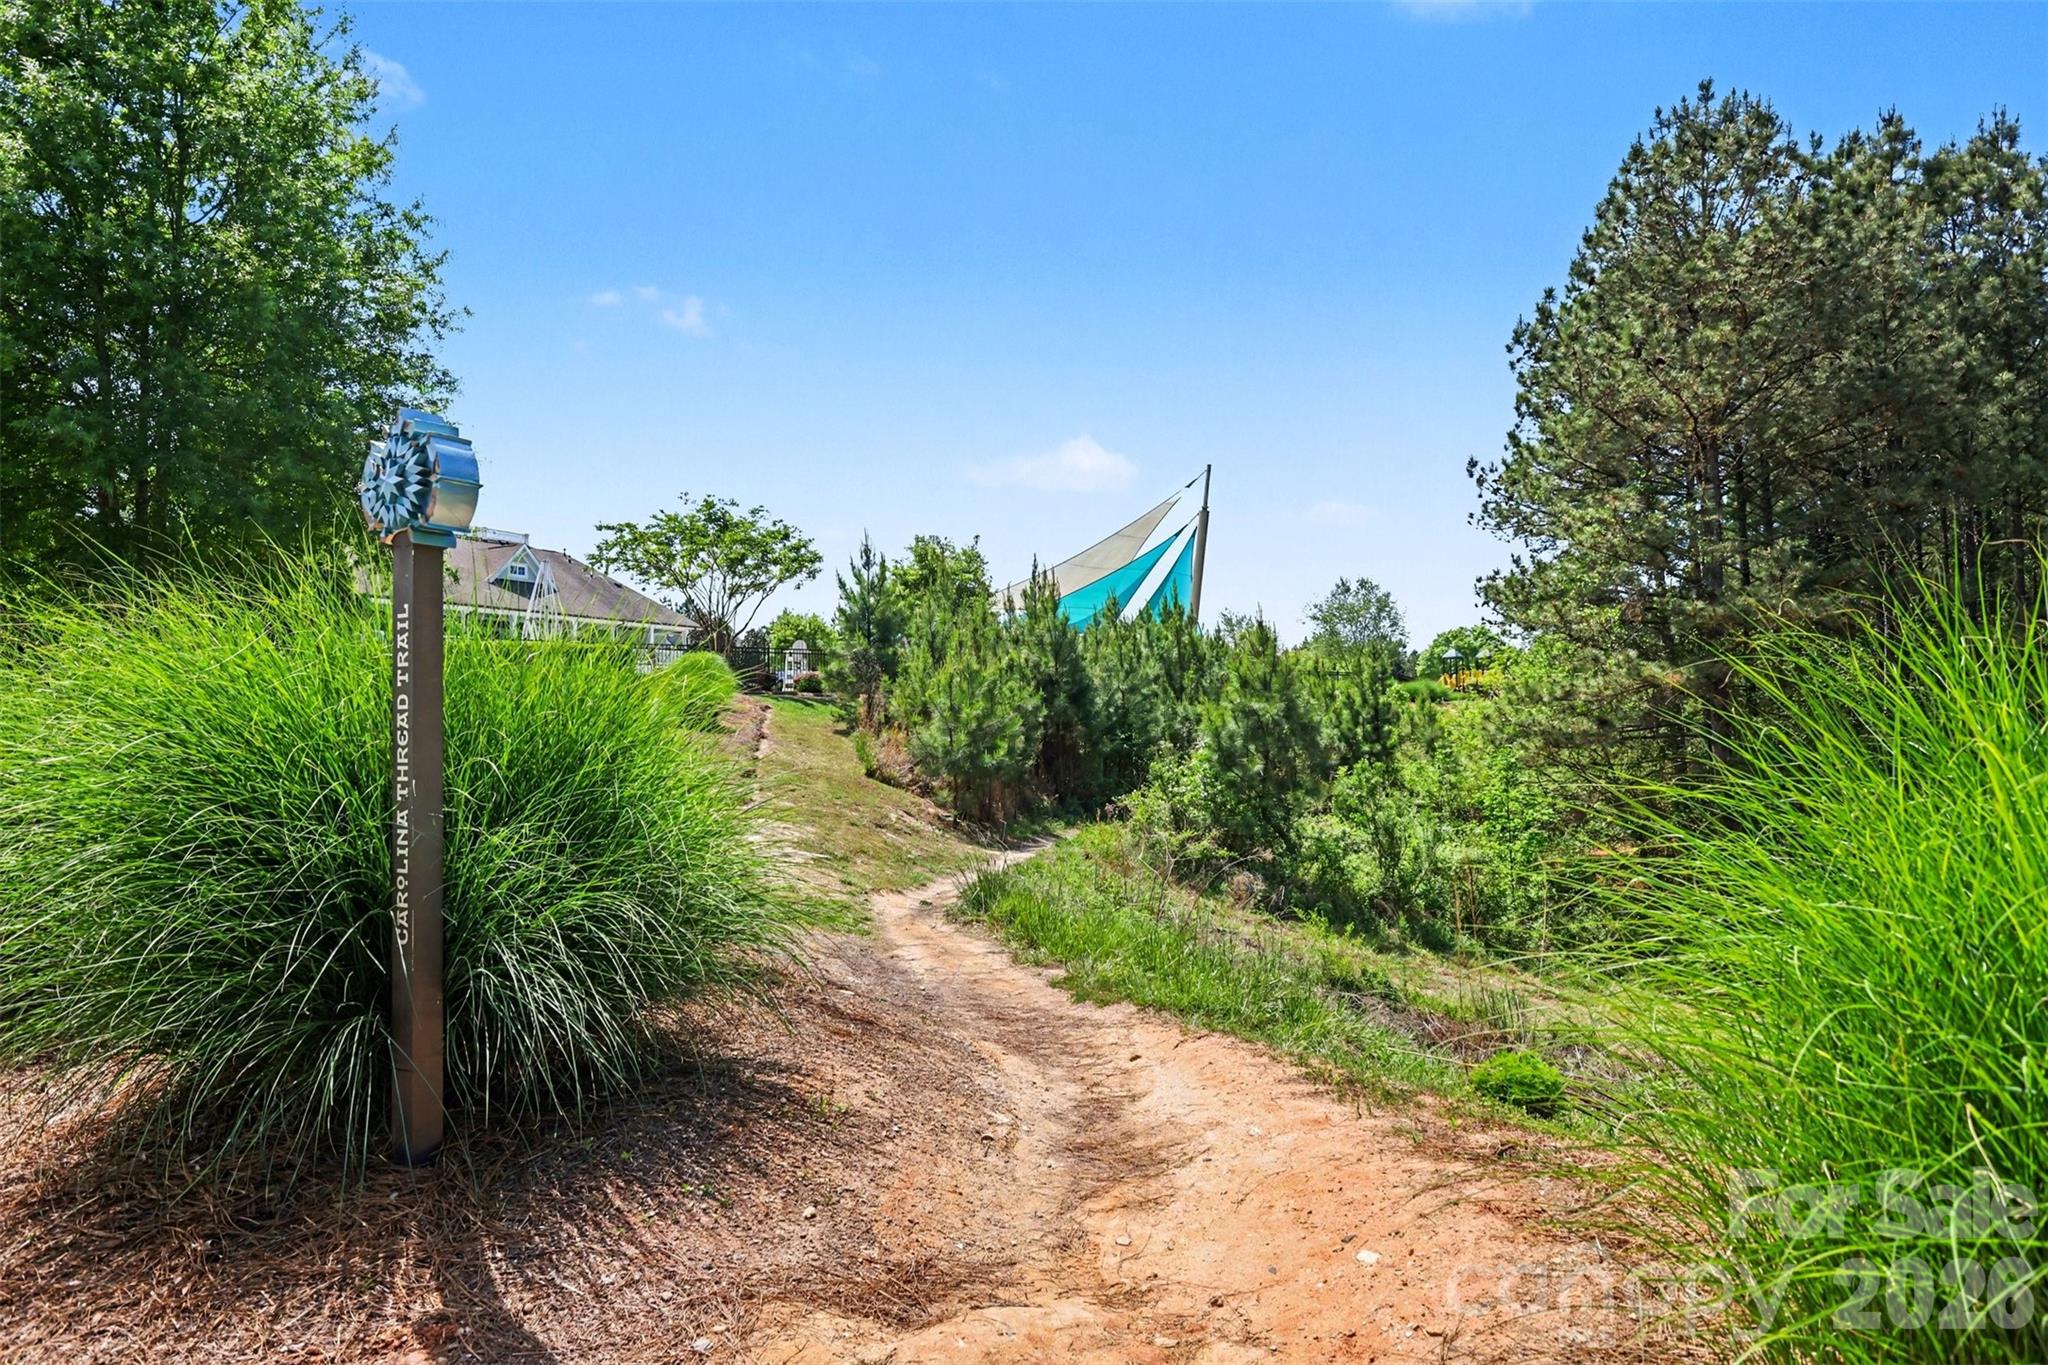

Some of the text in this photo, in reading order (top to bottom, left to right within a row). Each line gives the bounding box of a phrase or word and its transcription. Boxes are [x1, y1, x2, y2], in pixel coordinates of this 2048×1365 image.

[396, 603, 409, 946] CAROLINA THREAD TRAIL
